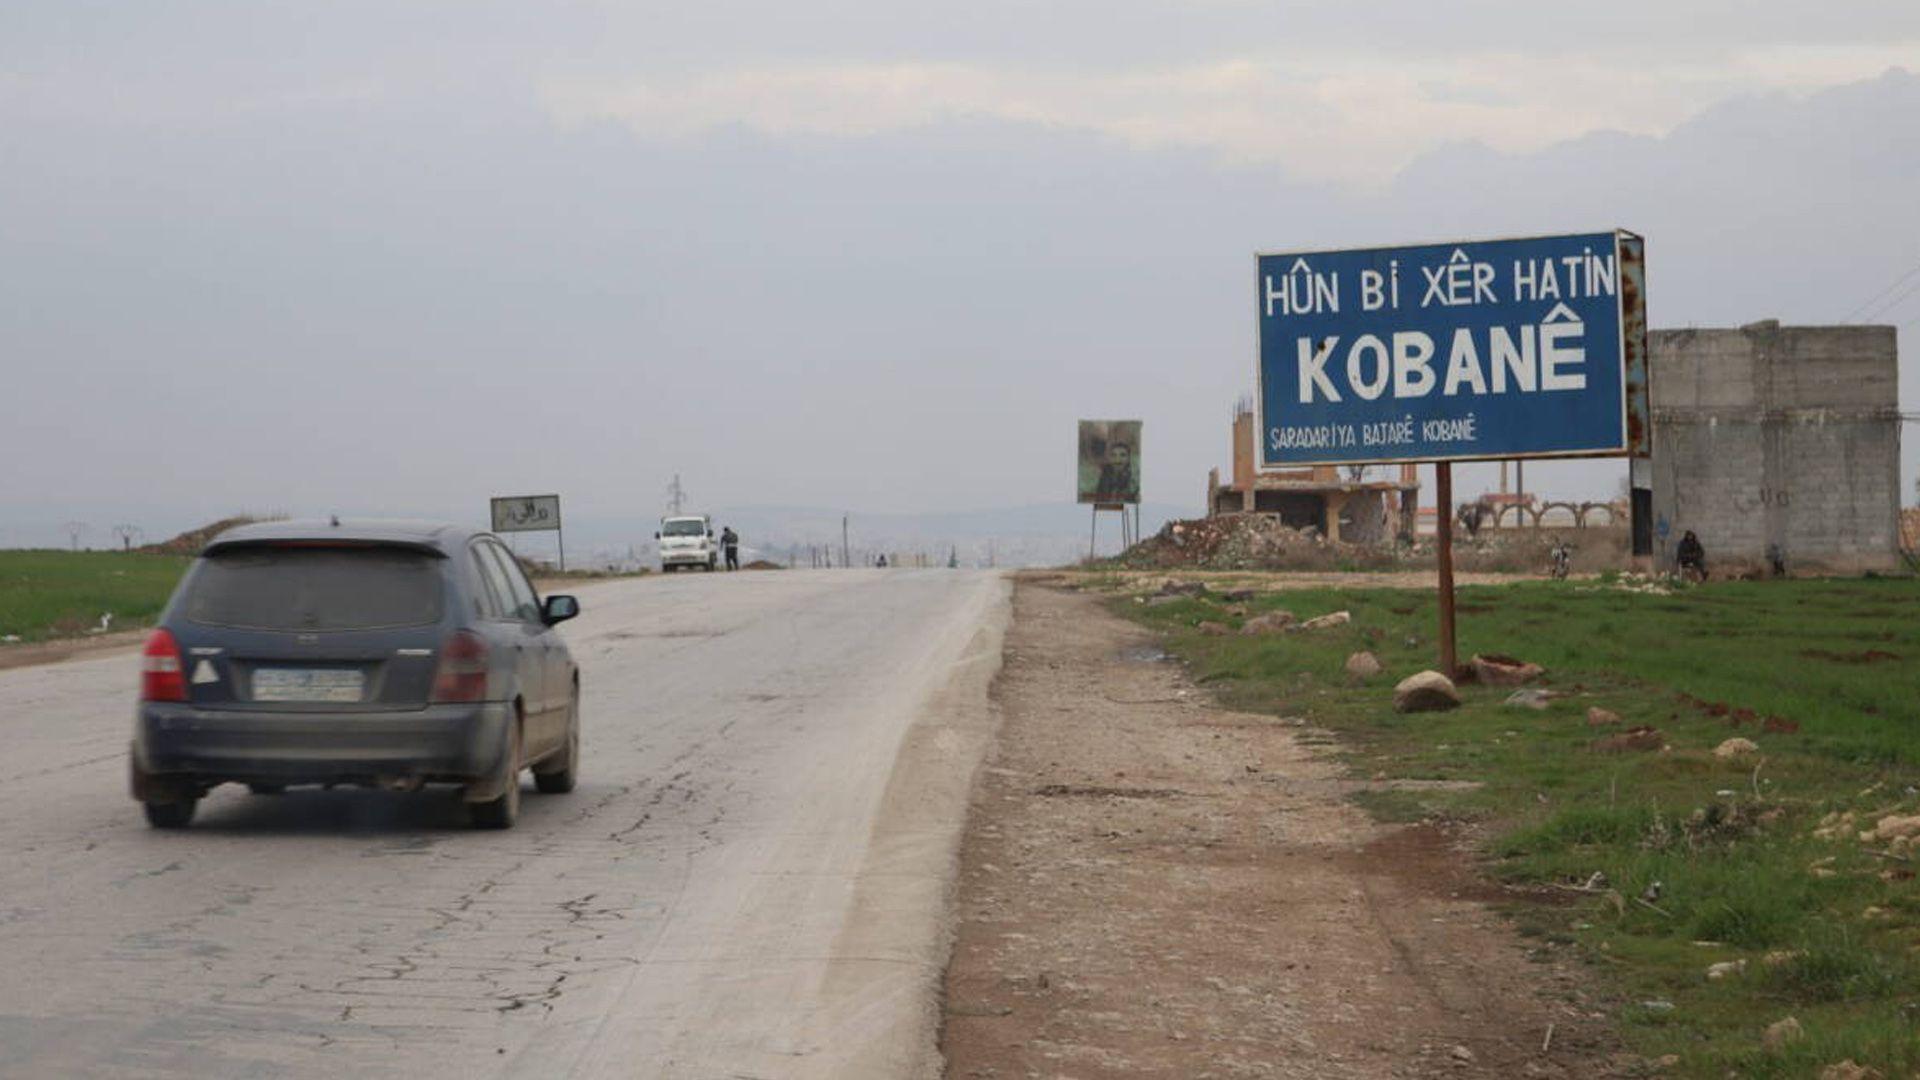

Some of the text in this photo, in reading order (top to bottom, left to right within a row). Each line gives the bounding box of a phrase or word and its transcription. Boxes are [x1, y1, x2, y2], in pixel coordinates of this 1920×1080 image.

[1265, 257, 1339, 316] HÛN
[1421, 248, 1497, 307] XÊR
[1297, 302, 1587, 404] KOBANÊ
